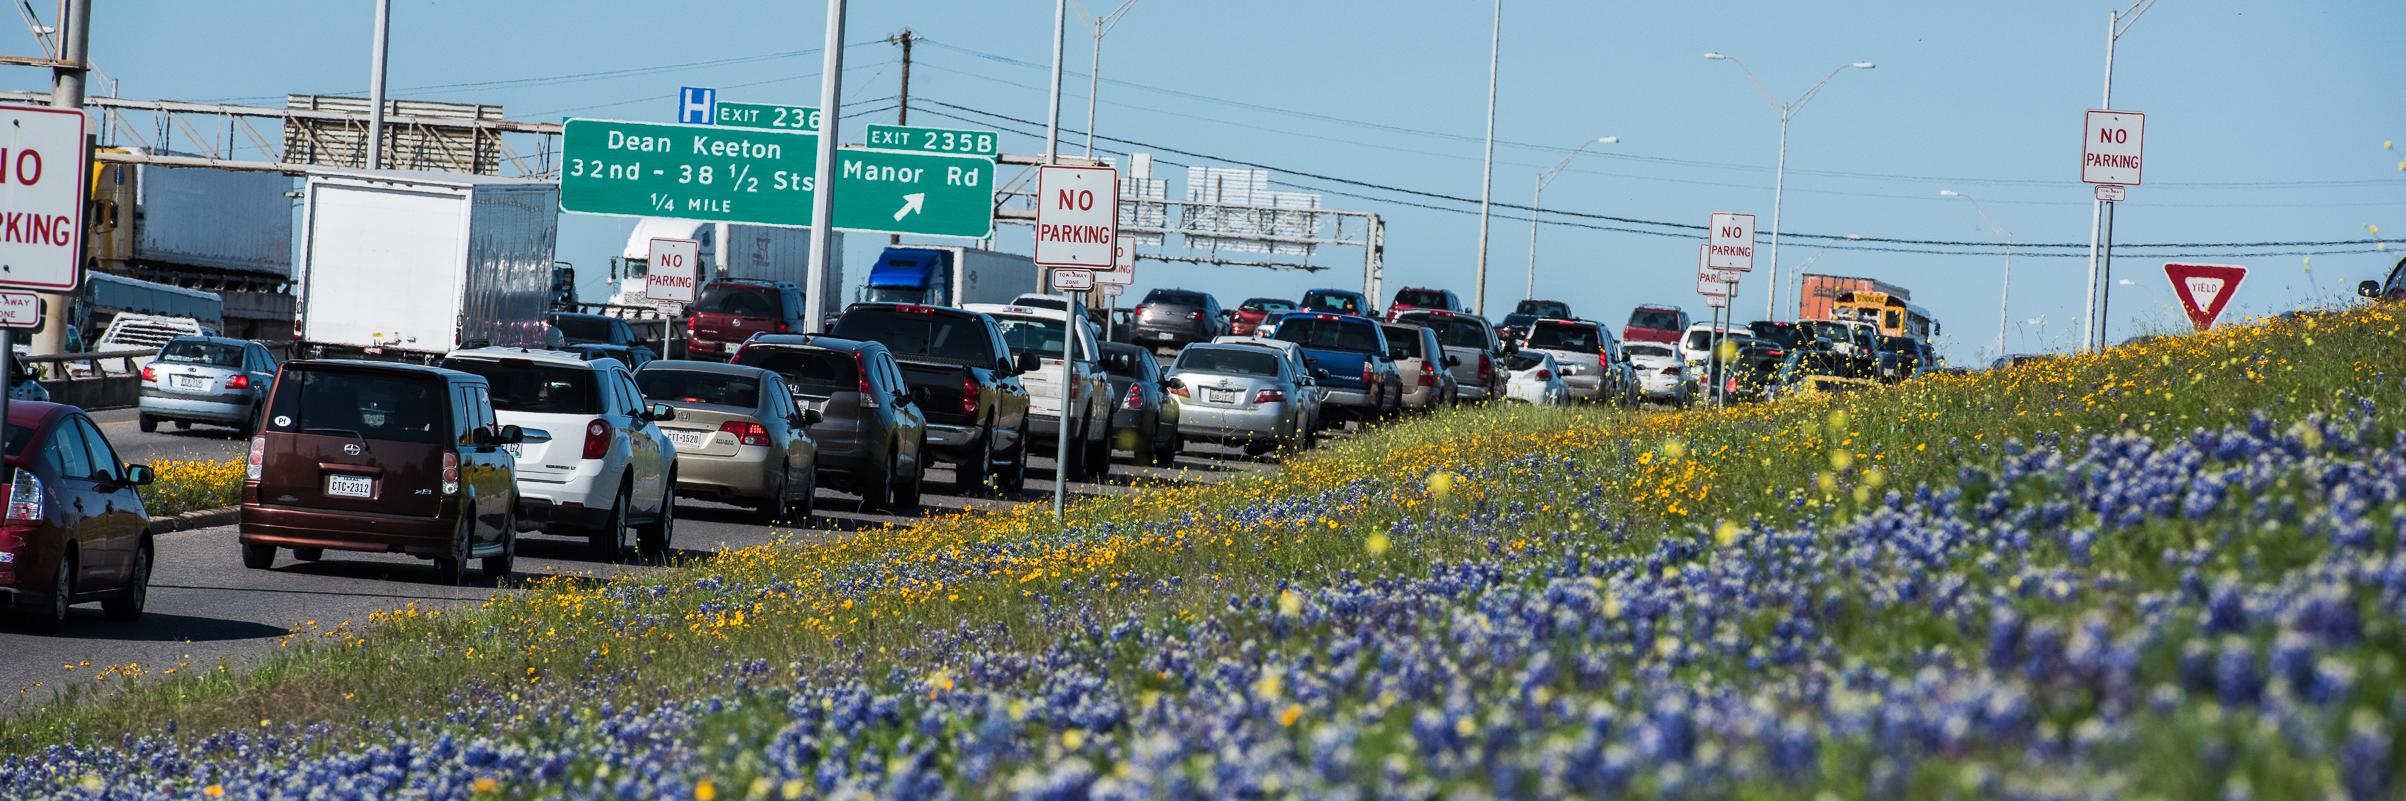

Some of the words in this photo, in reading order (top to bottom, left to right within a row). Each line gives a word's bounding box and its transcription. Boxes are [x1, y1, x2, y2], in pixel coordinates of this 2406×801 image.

[683, 88, 711, 123] H
[720, 107, 760, 123] EXIT
[772, 107, 822, 129] 236
[608, 130, 671, 152] Dean
[693, 135, 781, 159] Keeton
[871, 130, 911, 145] EXIT
[924, 132, 992, 153] 235B
[2100, 127, 2127, 144] NO
[2086, 152, 2139, 169] PARKING
[570, 158, 640, 181] 32nd
[678, 164, 713, 185] 38
[773, 170, 815, 192] Sts
[843, 159, 924, 184] Manor
[947, 166, 979, 187] Rd
[688, 198, 731, 213] MILE
[1058, 188, 1093, 211] NO
[0, 211, 71, 247] KING
[1040, 223, 1110, 244] PARKING
[1721, 225, 1742, 239] NO
[661, 253, 683, 268] NO
[1711, 244, 1751, 257] PARKING
[649, 274, 692, 288] PARKING
[2192, 282, 2217, 293] YIELD
